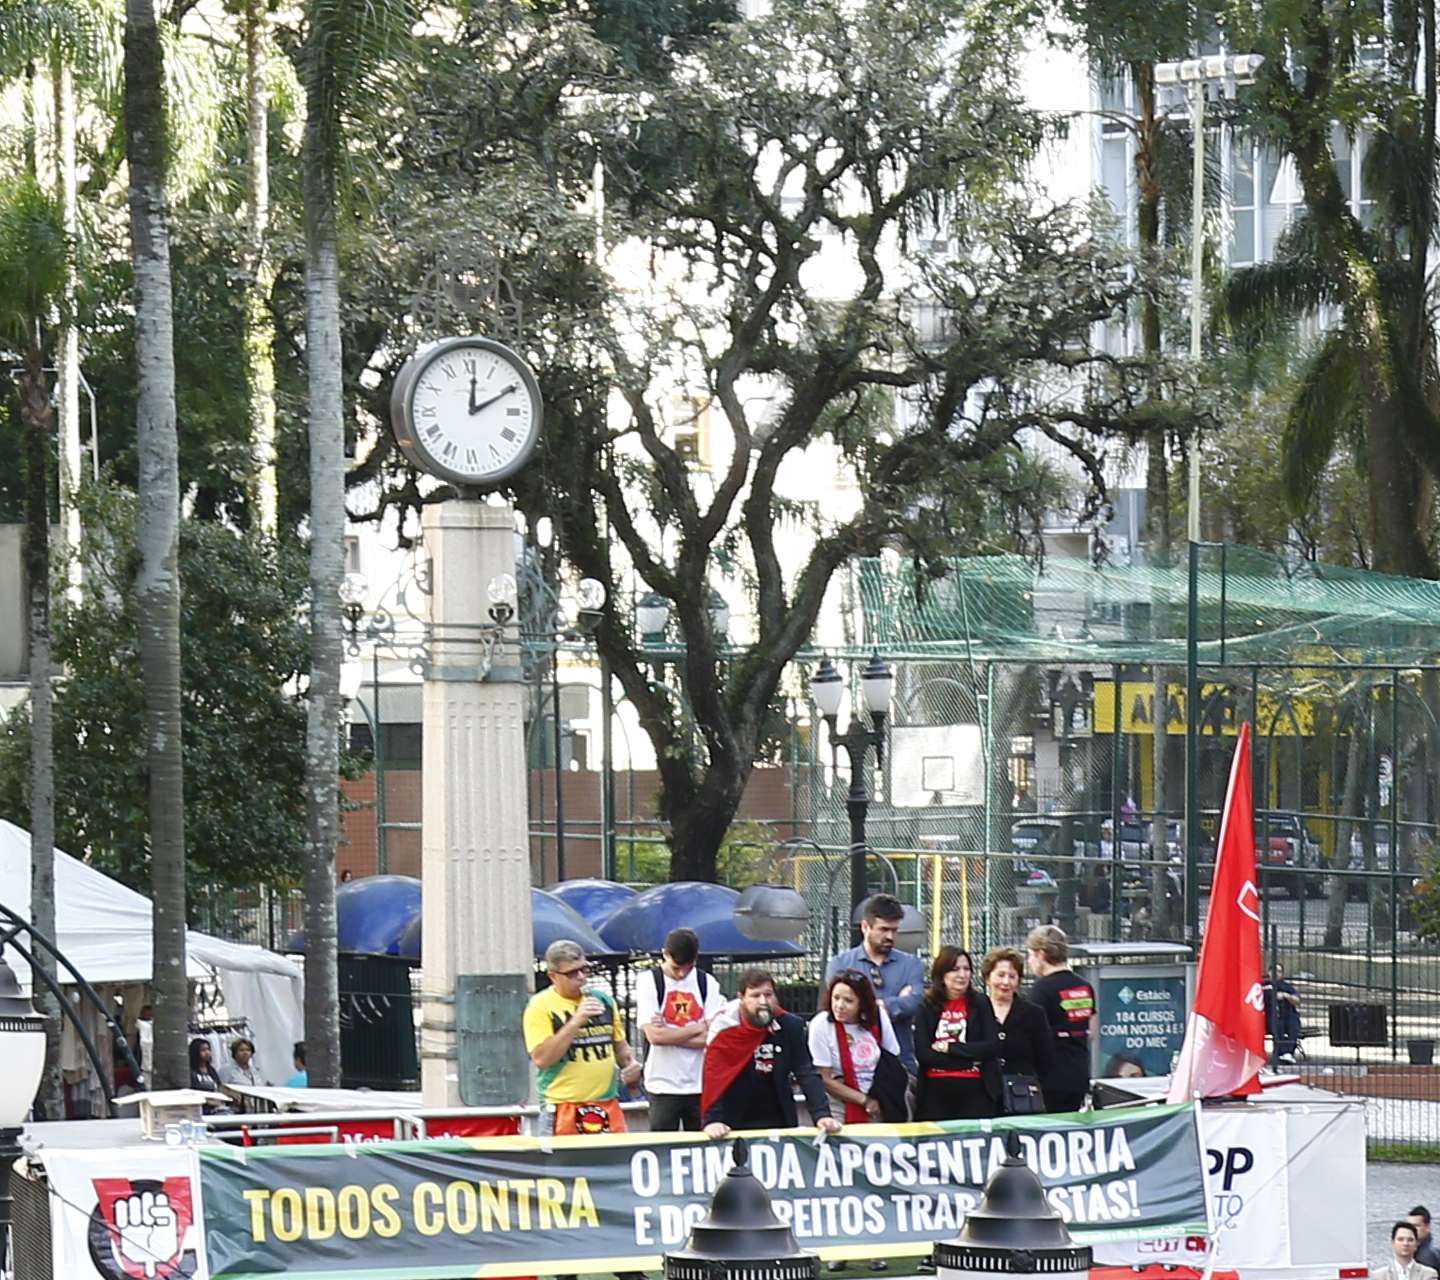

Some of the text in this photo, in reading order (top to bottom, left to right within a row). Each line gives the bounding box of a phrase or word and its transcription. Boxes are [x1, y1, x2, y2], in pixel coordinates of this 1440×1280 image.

[1102, 1024, 1131, 1036] COM
[1131, 1023, 1164, 1036] NOTAS
[1137, 1010, 1175, 1022] CURSOS
[1144, 1037, 1168, 1049] MEC
[630, 1149, 660, 1198] O
[760, 1143, 806, 1190] DA
[243, 1176, 601, 1244] TODOS CONTRA
[634, 1205, 653, 1246] E
